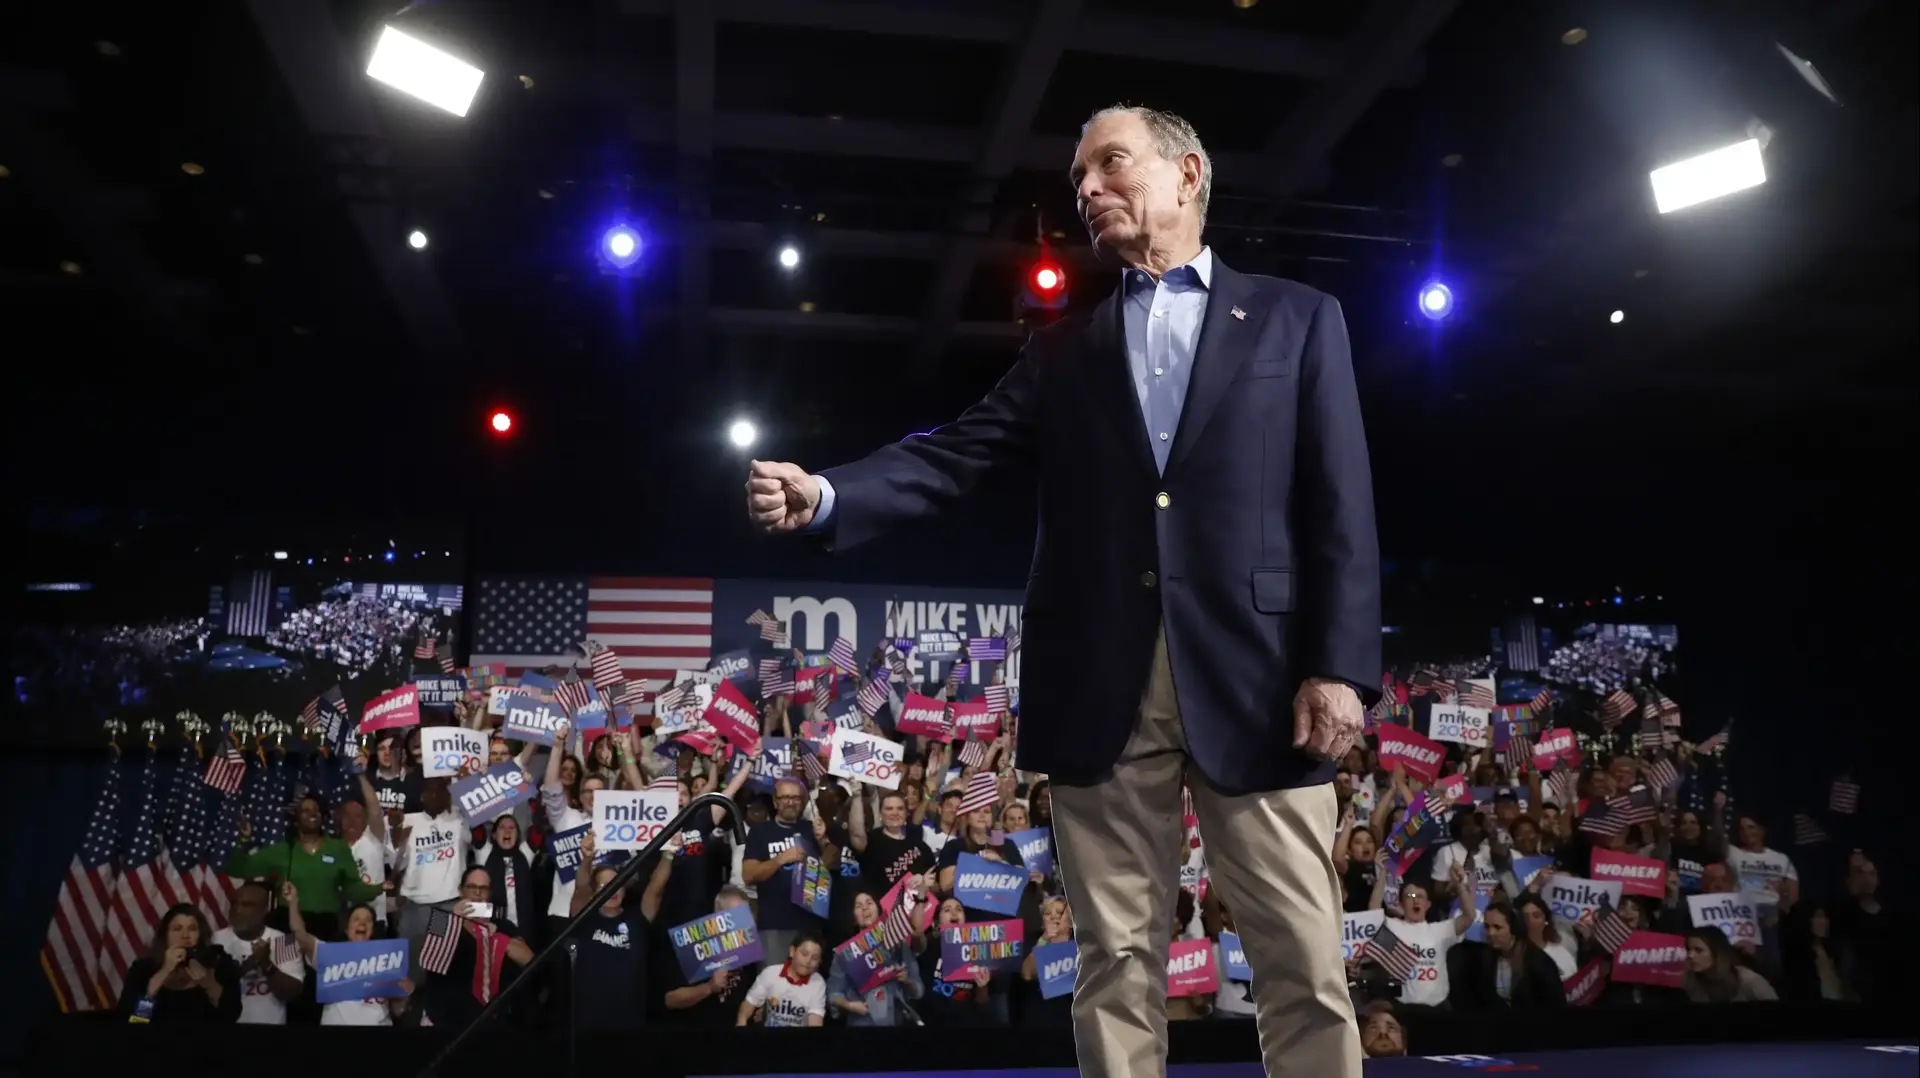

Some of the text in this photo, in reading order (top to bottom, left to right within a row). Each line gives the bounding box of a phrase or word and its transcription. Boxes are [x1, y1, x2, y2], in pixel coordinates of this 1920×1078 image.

[886, 601, 1023, 640] MIKE WI
[363, 692, 415, 722] WOMEN
[509, 707, 572, 732] mike
[1438, 712, 1482, 728] mike
[1437, 725, 1480, 741] 2020
[433, 734, 481, 755] mike
[1381, 740, 1440, 765] WOMEN
[433, 752, 481, 772] 2020
[460, 771, 524, 812] mike
[605, 800, 668, 825] mike
[416, 830, 454, 847] mike
[603, 823, 667, 843] 2020
[416, 847, 455, 866] 2020
[1595, 861, 1660, 880] WOMEN
[957, 873, 1023, 891] WOMEN
[1701, 901, 1752, 920] mike
[673, 912, 737, 948] GANAMOS
[944, 924, 1005, 944] GANAMOS
[1343, 919, 1377, 941] ike
[694, 927, 755, 961] CON MIKE
[961, 940, 1020, 962] CON MIKE
[1411, 943, 1437, 959] ike
[1167, 949, 1208, 976] MEN
[1617, 946, 1688, 965] WOMEN
[323, 950, 404, 984] WOMEN
